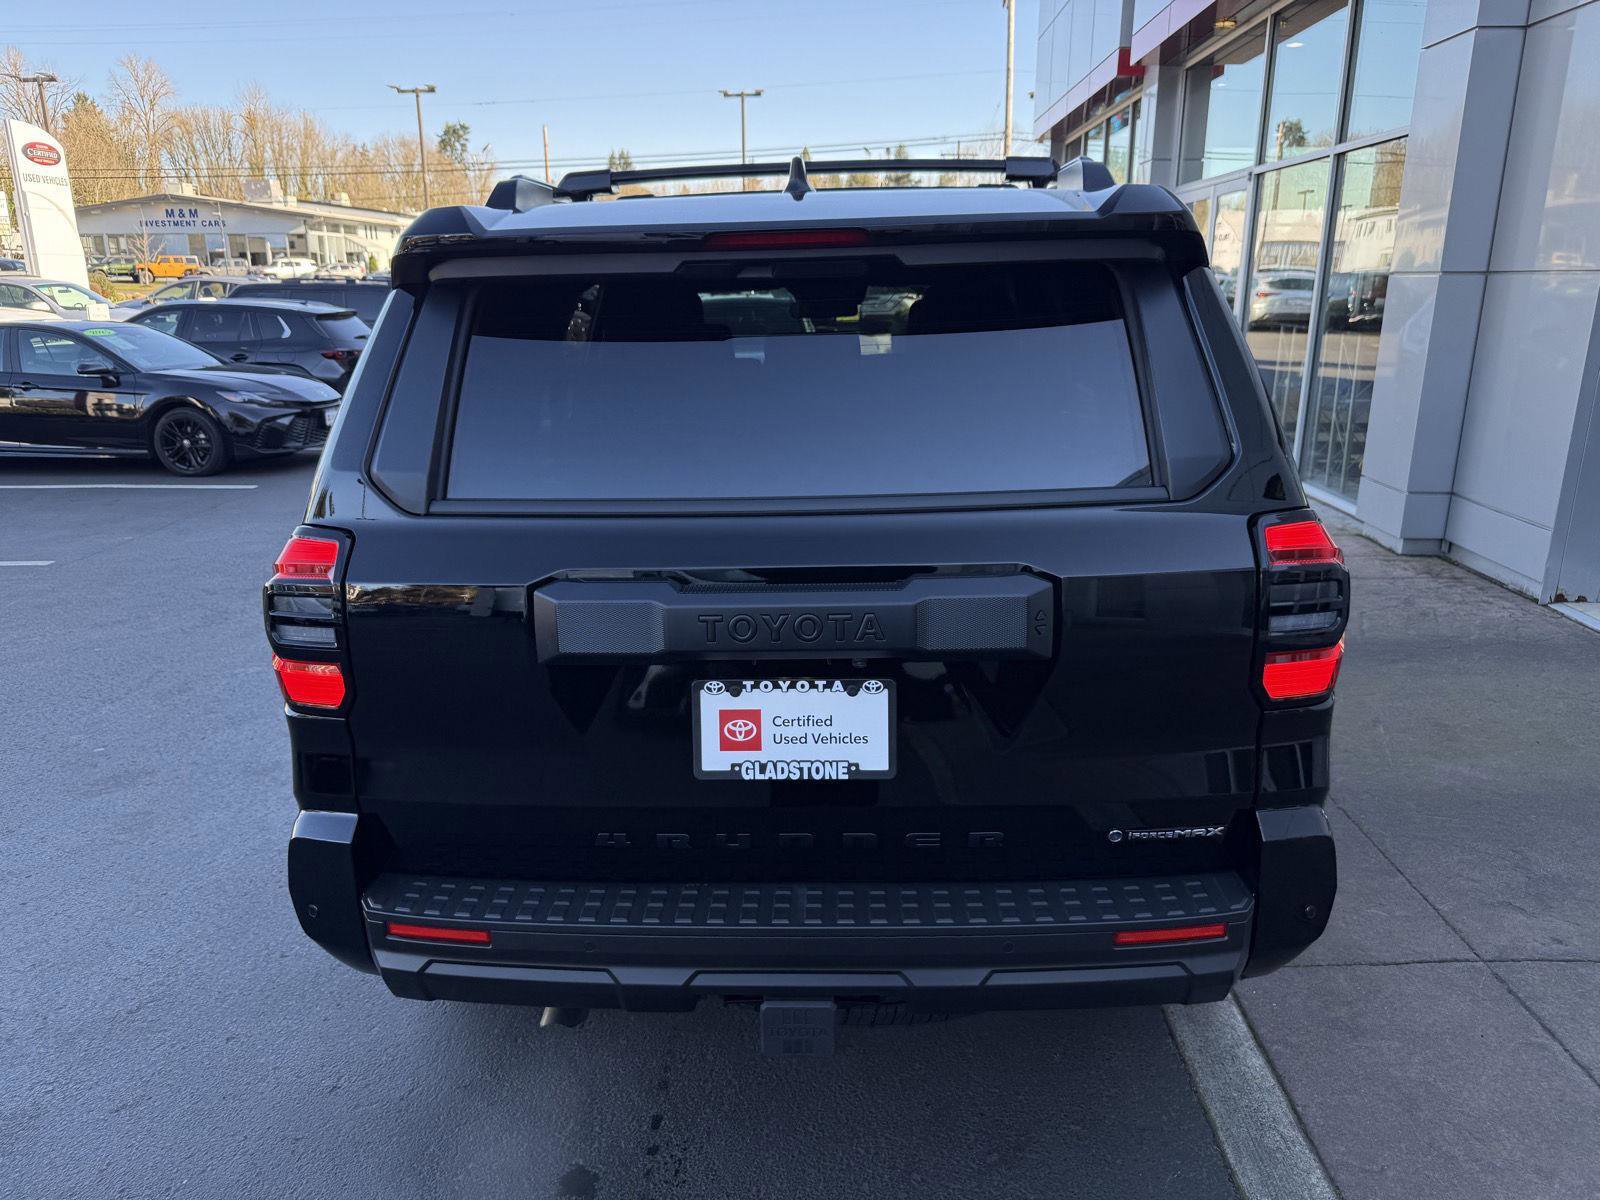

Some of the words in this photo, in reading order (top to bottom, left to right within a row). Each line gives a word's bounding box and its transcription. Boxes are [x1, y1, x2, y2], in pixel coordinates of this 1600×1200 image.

[23, 173, 41, 183] USED
[42, 175, 68, 187] VEHICLES
[165, 208, 176, 219] M
[178, 208, 186, 218] &
[189, 208, 199, 219] M
[201, 220, 226, 228] CARS
[698, 613, 887, 644] TOYOTA
[742, 680, 845, 693] TOYOTA
[772, 715, 833, 727] Certified
[773, 733, 808, 745] Used
[812, 733, 869, 745] Vehicles
[740, 760, 850, 780] GLADSTONE
